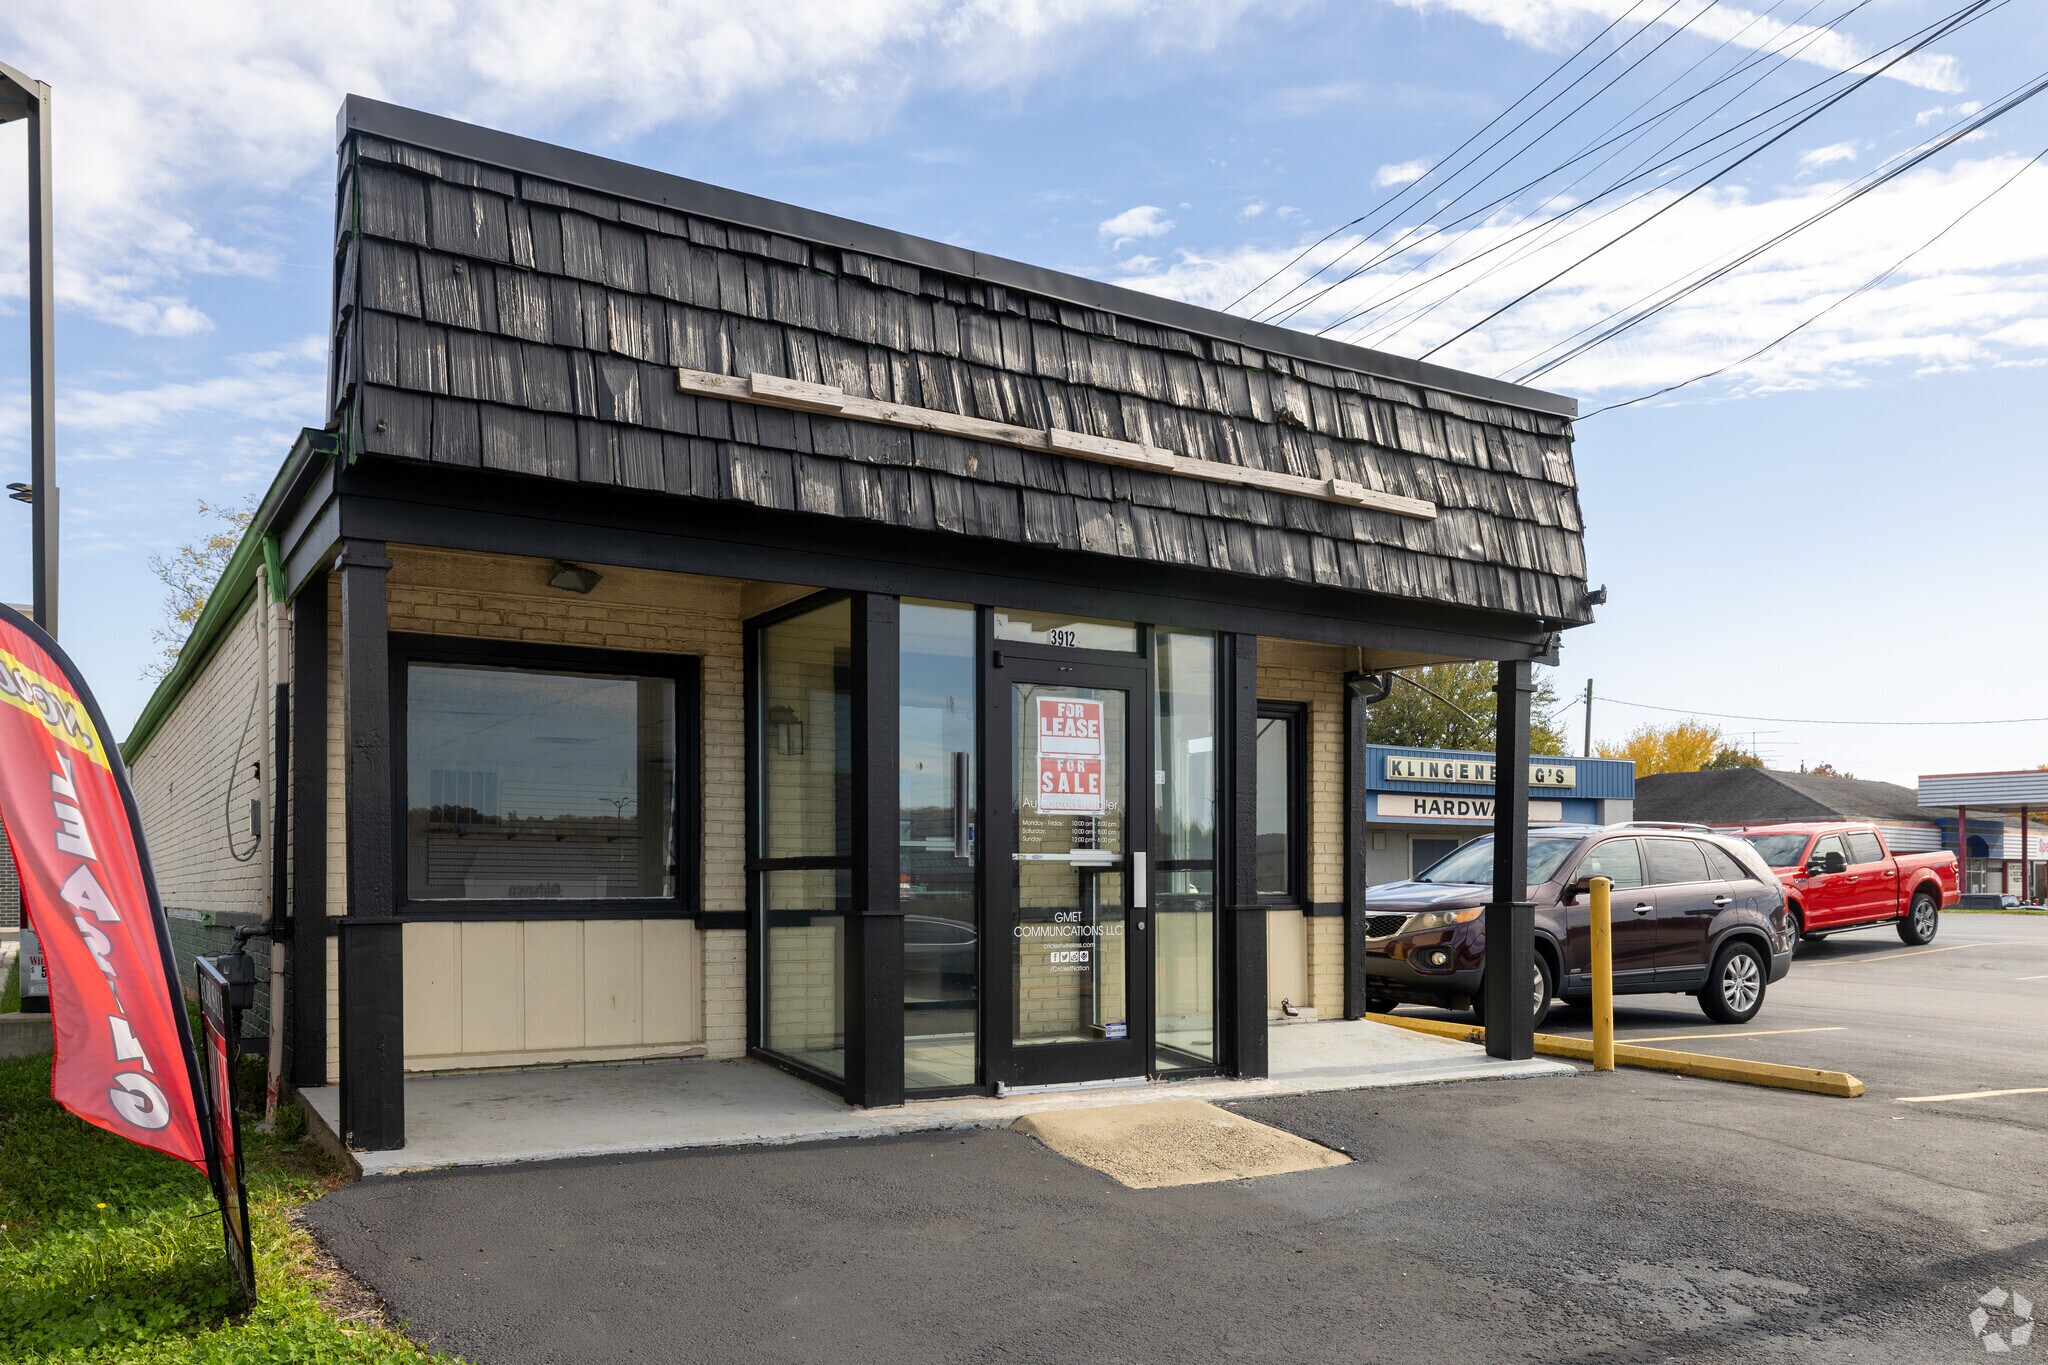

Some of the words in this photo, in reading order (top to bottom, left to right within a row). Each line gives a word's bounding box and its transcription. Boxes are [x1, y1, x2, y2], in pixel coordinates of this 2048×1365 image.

[1051, 629, 1075, 646] 3912
[1057, 703, 1084, 718] FOR
[1041, 717, 1099, 737] LEASE
[1057, 759, 1085, 773] FOR
[1392, 760, 1564, 784] KLINGENBG'S
[1042, 771, 1099, 793] SALE
[1022, 797, 1077, 809] Auhorized
[1414, 799, 1529, 817] HARDW
[1054, 911, 1082, 923] GMET
[1013, 925, 1103, 937] COMMUNCATIONS
[1106, 925, 1123, 936] LLC
[1043, 942, 1095, 950] cricketwireless.com
